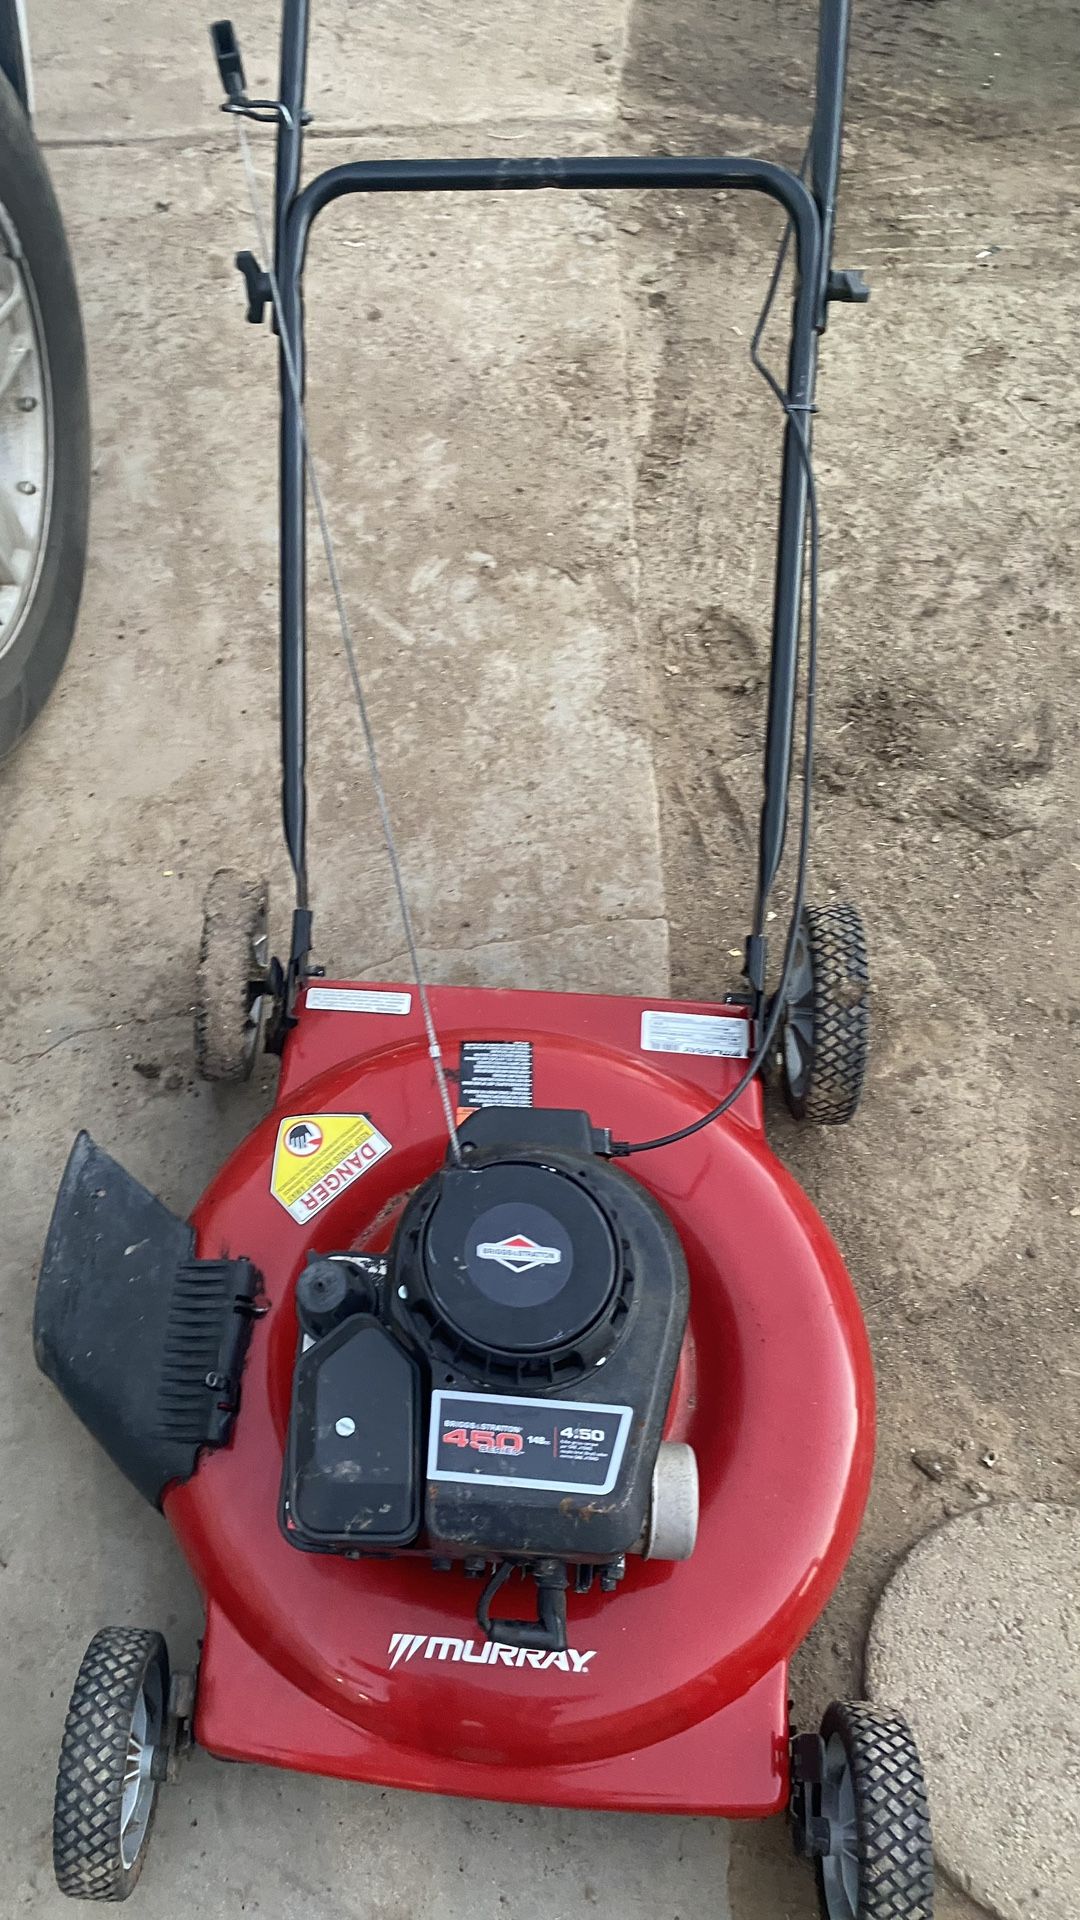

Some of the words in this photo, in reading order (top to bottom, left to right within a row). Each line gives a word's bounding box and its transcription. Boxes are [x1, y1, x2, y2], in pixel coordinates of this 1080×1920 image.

[301, 1143, 377, 1210] DANGER
[442, 1428, 524, 1451] 450
[424, 1636, 598, 1673] MURRAY
